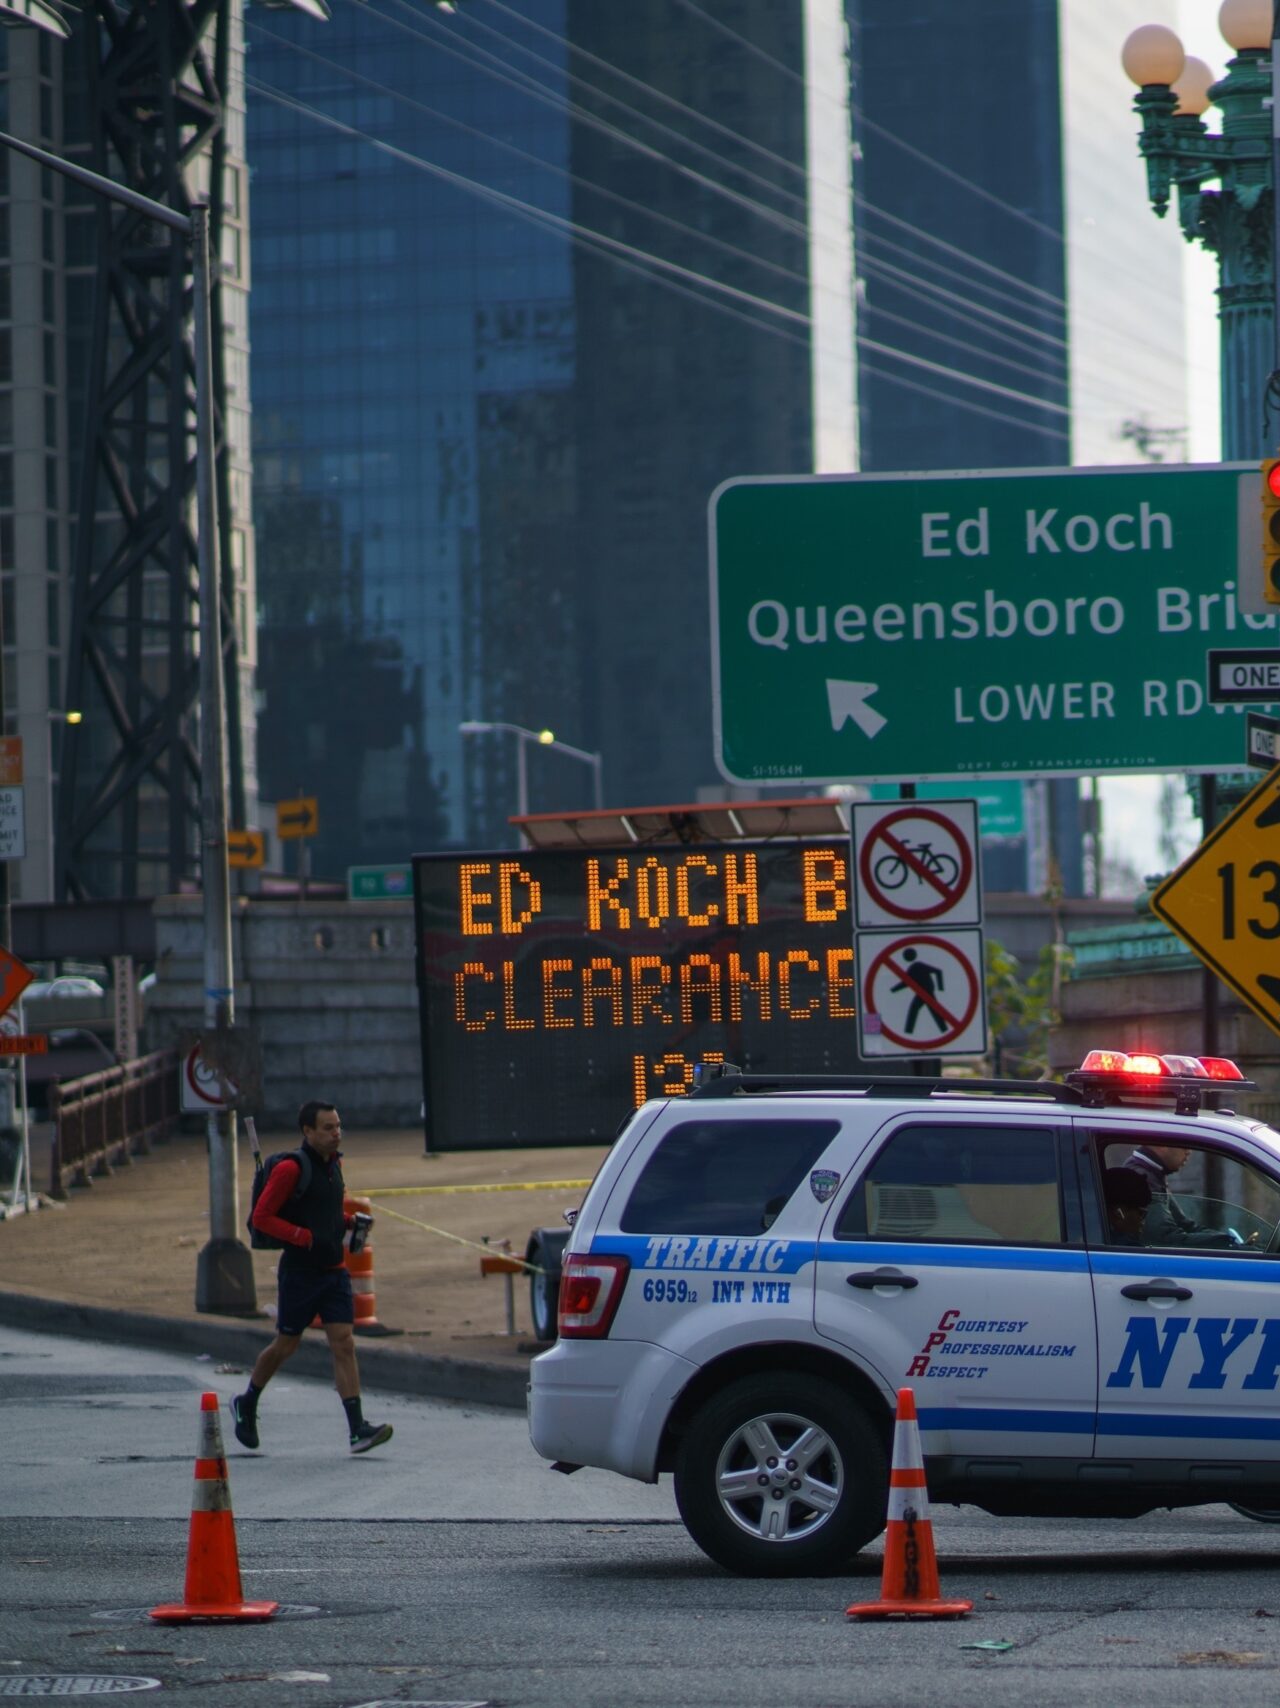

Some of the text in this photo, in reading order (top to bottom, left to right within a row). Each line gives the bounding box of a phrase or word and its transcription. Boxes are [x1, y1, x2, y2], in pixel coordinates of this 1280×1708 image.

[921, 501, 1174, 558] Ed Koch
[746, 589, 1126, 652] Queensboro
[1232, 665, 1280, 688] ONE
[954, 678, 1273, 724] LOWER RD
[957, 756, 1157, 771] DEPT OF TRANSPORTATION
[1255, 731, 1275, 756] ONE
[460, 849, 848, 936] ED KOCH B
[455, 946, 857, 1032] CLEARANCE
[643, 1237, 791, 1273] TRAFFIC
[712, 1279, 745, 1304] INT
[752, 1281, 791, 1304] NTH
